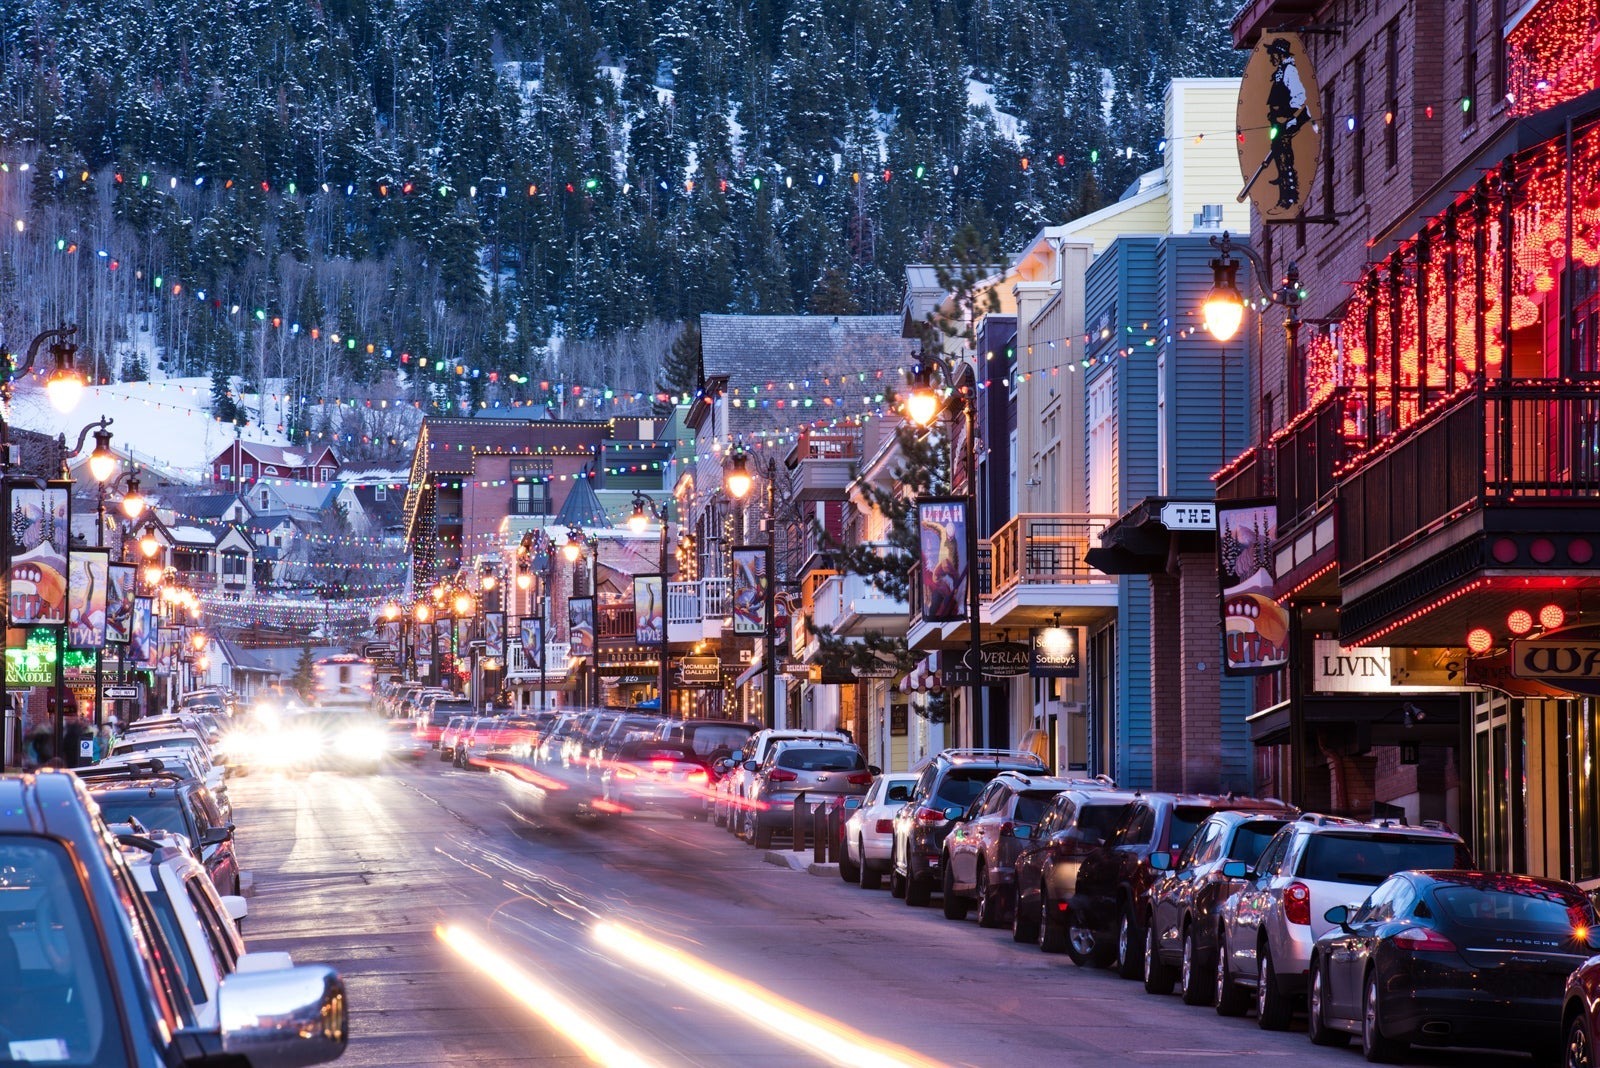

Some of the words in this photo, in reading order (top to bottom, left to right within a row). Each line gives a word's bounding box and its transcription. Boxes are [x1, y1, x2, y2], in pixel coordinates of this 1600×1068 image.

[922, 505, 963, 522] UTAH
[1176, 508, 1211, 523] THE
[12, 594, 66, 620] UTAH
[735, 623, 764, 631] UTAH
[1228, 632, 1288, 663] UTAH
[1036, 655, 1076, 666] Sotheby's
[1496, 938, 1559, 946] PORSCHE
